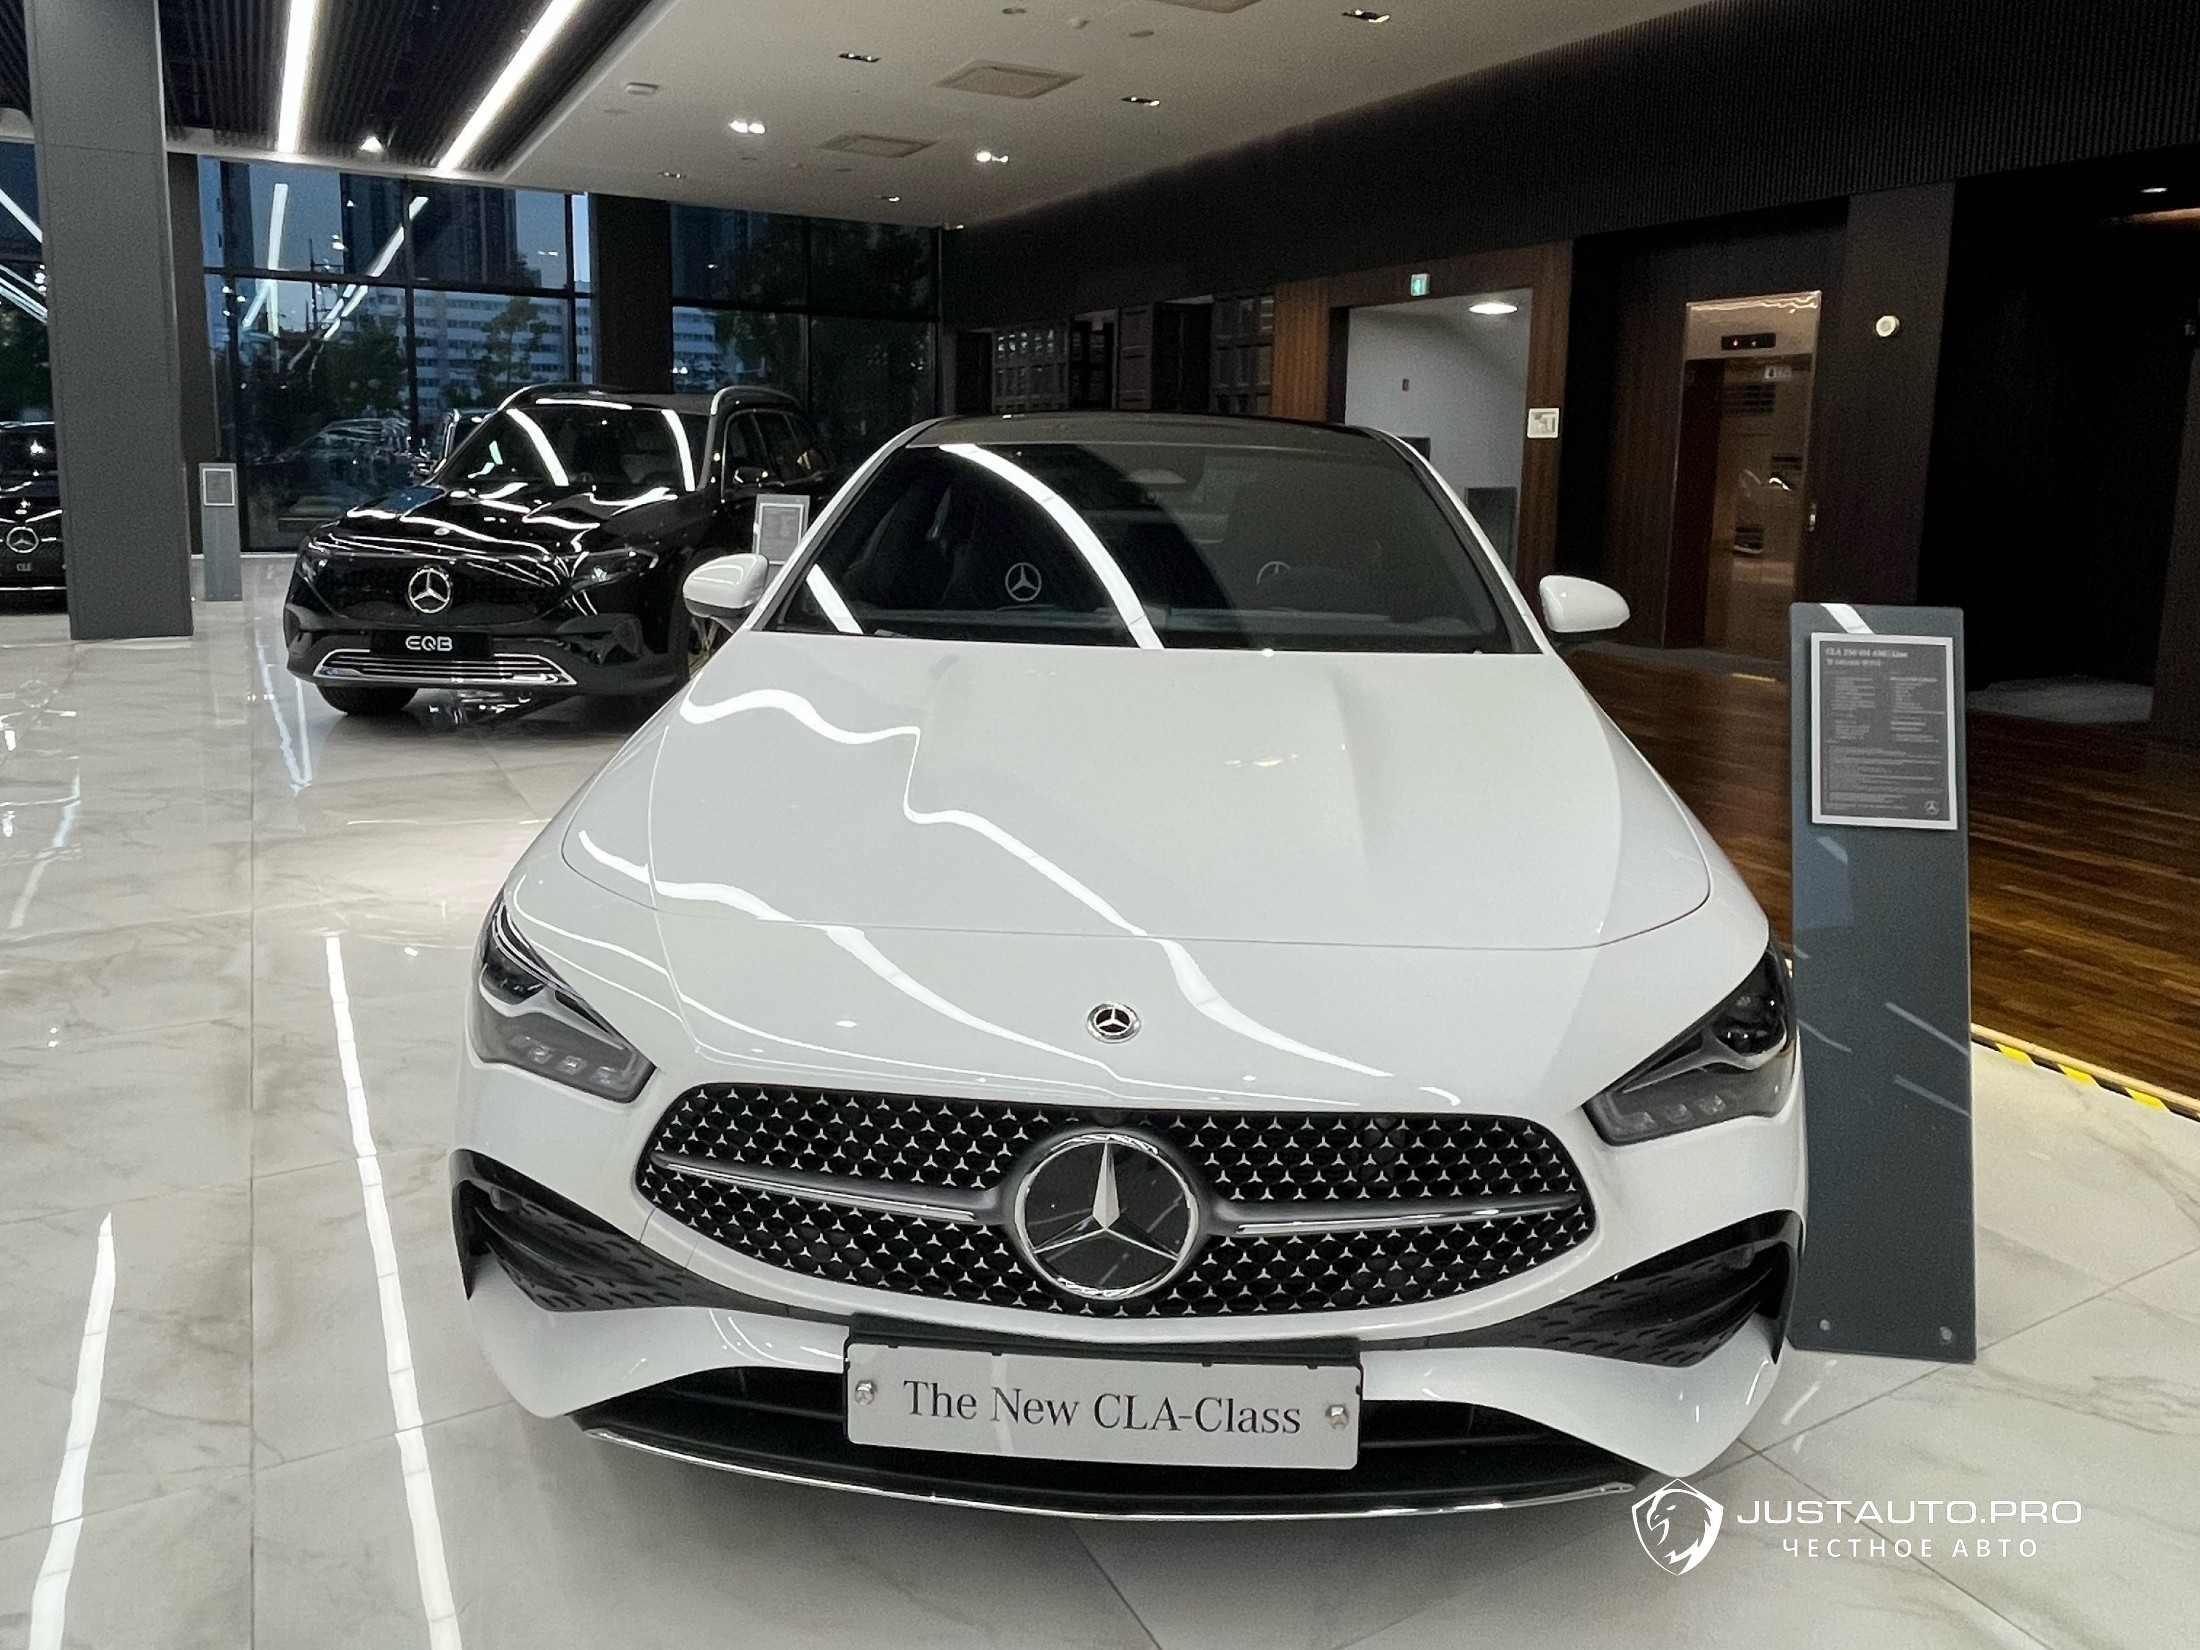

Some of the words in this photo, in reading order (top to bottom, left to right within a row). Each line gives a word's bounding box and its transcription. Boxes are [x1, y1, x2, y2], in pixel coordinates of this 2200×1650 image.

[405, 635, 453, 652] EQB
[903, 1380, 977, 1420] The
[991, 1386, 1080, 1427] New
[1093, 1393, 1302, 1434] CLA-Class
